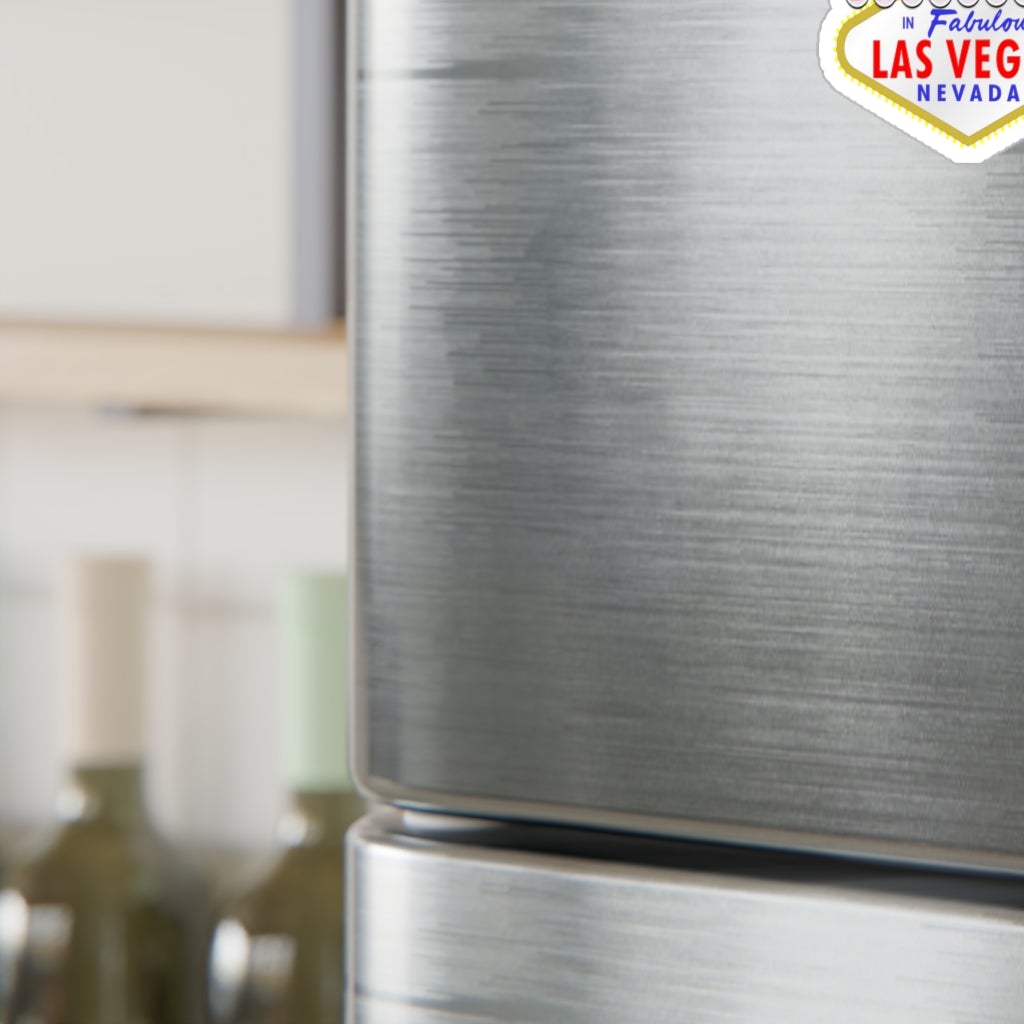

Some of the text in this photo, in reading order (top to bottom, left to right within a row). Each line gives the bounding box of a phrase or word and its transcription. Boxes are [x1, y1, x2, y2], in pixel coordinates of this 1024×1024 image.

[902, 16, 914, 29] IN
[873, 39, 932, 79] LAS
[917, 84, 1020, 102] NEVADA
